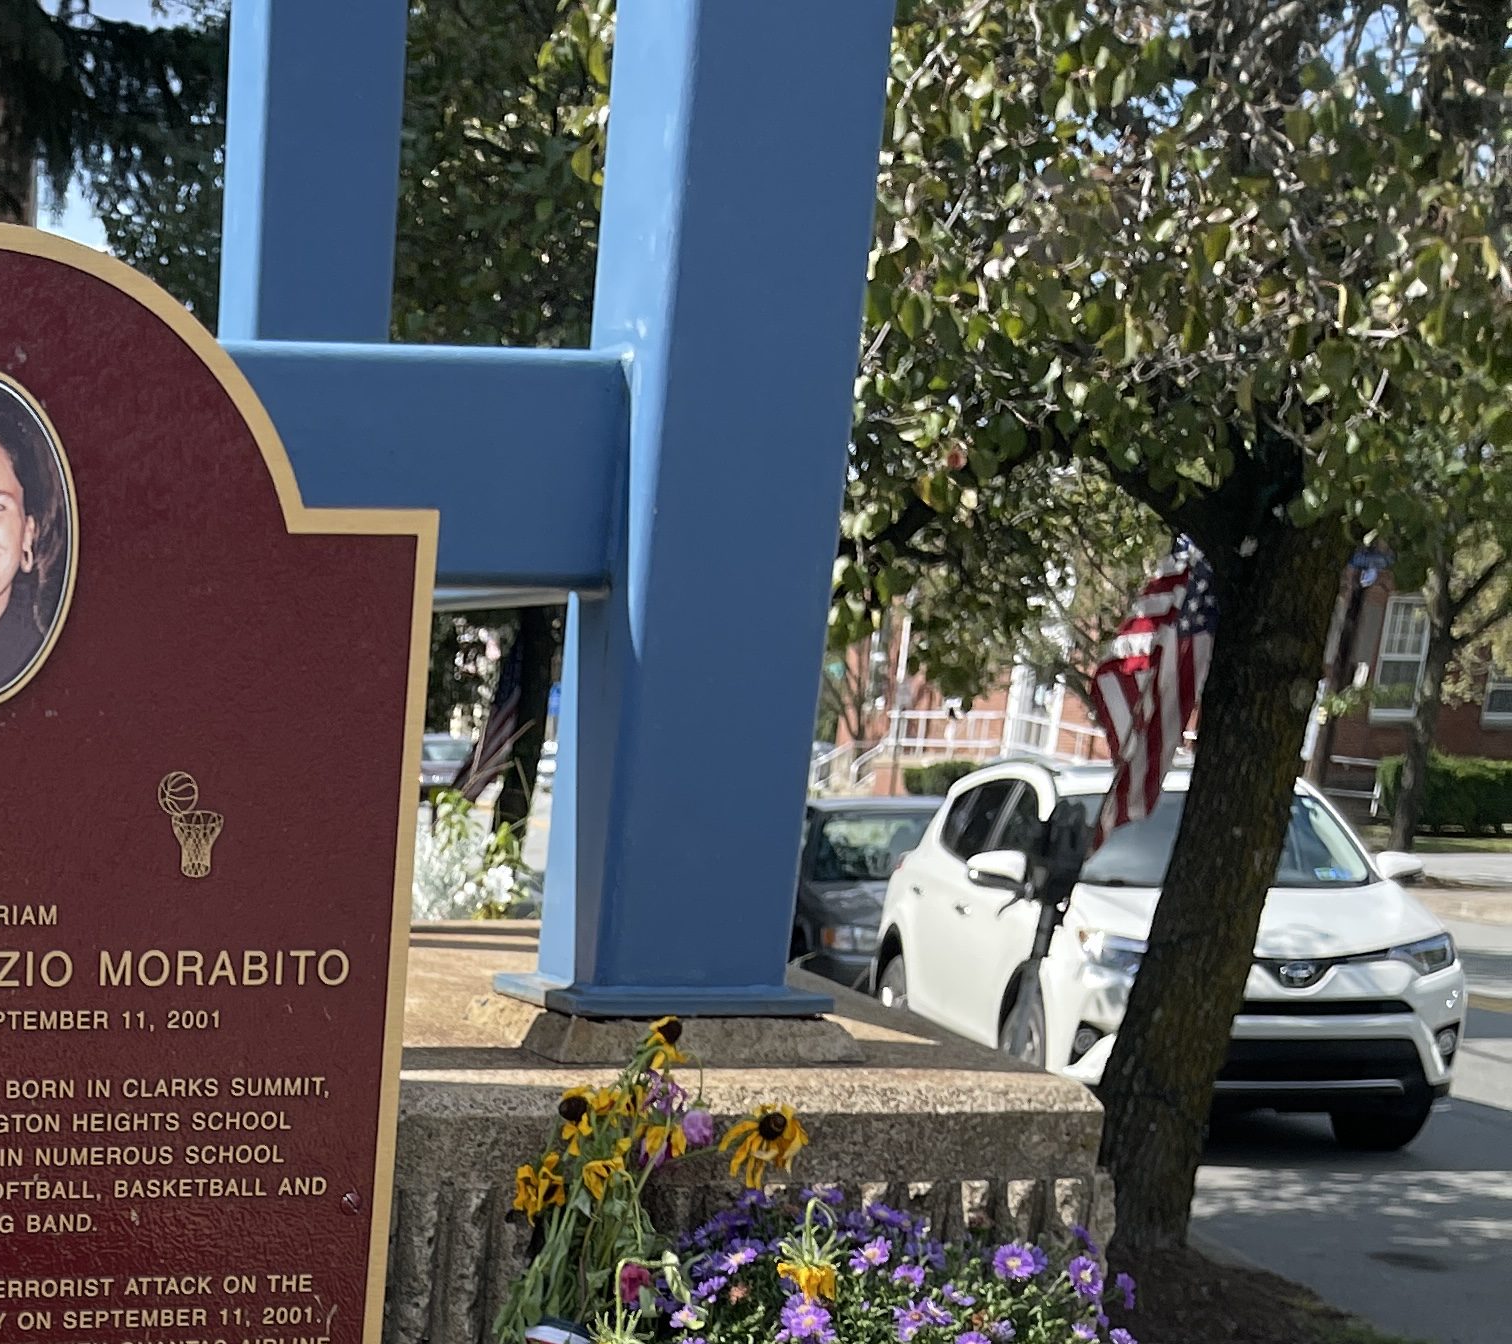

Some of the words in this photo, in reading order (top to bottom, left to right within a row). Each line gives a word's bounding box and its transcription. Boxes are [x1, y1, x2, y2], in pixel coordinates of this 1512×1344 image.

[99, 949, 350, 987] MORABITO
[122, 1011, 155, 1032] 11,
[166, 1010, 220, 1029] 2001
[5, 1079, 75, 1099] BORN
[87, 1079, 111, 1098] IN
[122, 1078, 219, 1098] CLARKS
[230, 1077, 329, 1099] SUMMIT,
[72, 1112, 180, 1132] HEIGHTS
[191, 1111, 292, 1131] SCHOOL
[0, 1147, 23, 1166] IN
[35, 1146, 174, 1166] NUMEROUS
[184, 1144, 285, 1164] SCHOOL
[113, 1177, 268, 1199] BASKETBALL
[277, 1176, 328, 1196] AND
[26, 1213, 98, 1235] BAND.
[123, 1275, 213, 1296] ATTACK
[222, 1275, 257, 1295] ON
[266, 1273, 313, 1293] THE
[17, 1311, 52, 1330] ON
[62, 1308, 207, 1329] SEPTEMBER
[219, 1307, 251, 1328] 11,
[262, 1306, 324, 1326] 2001.
